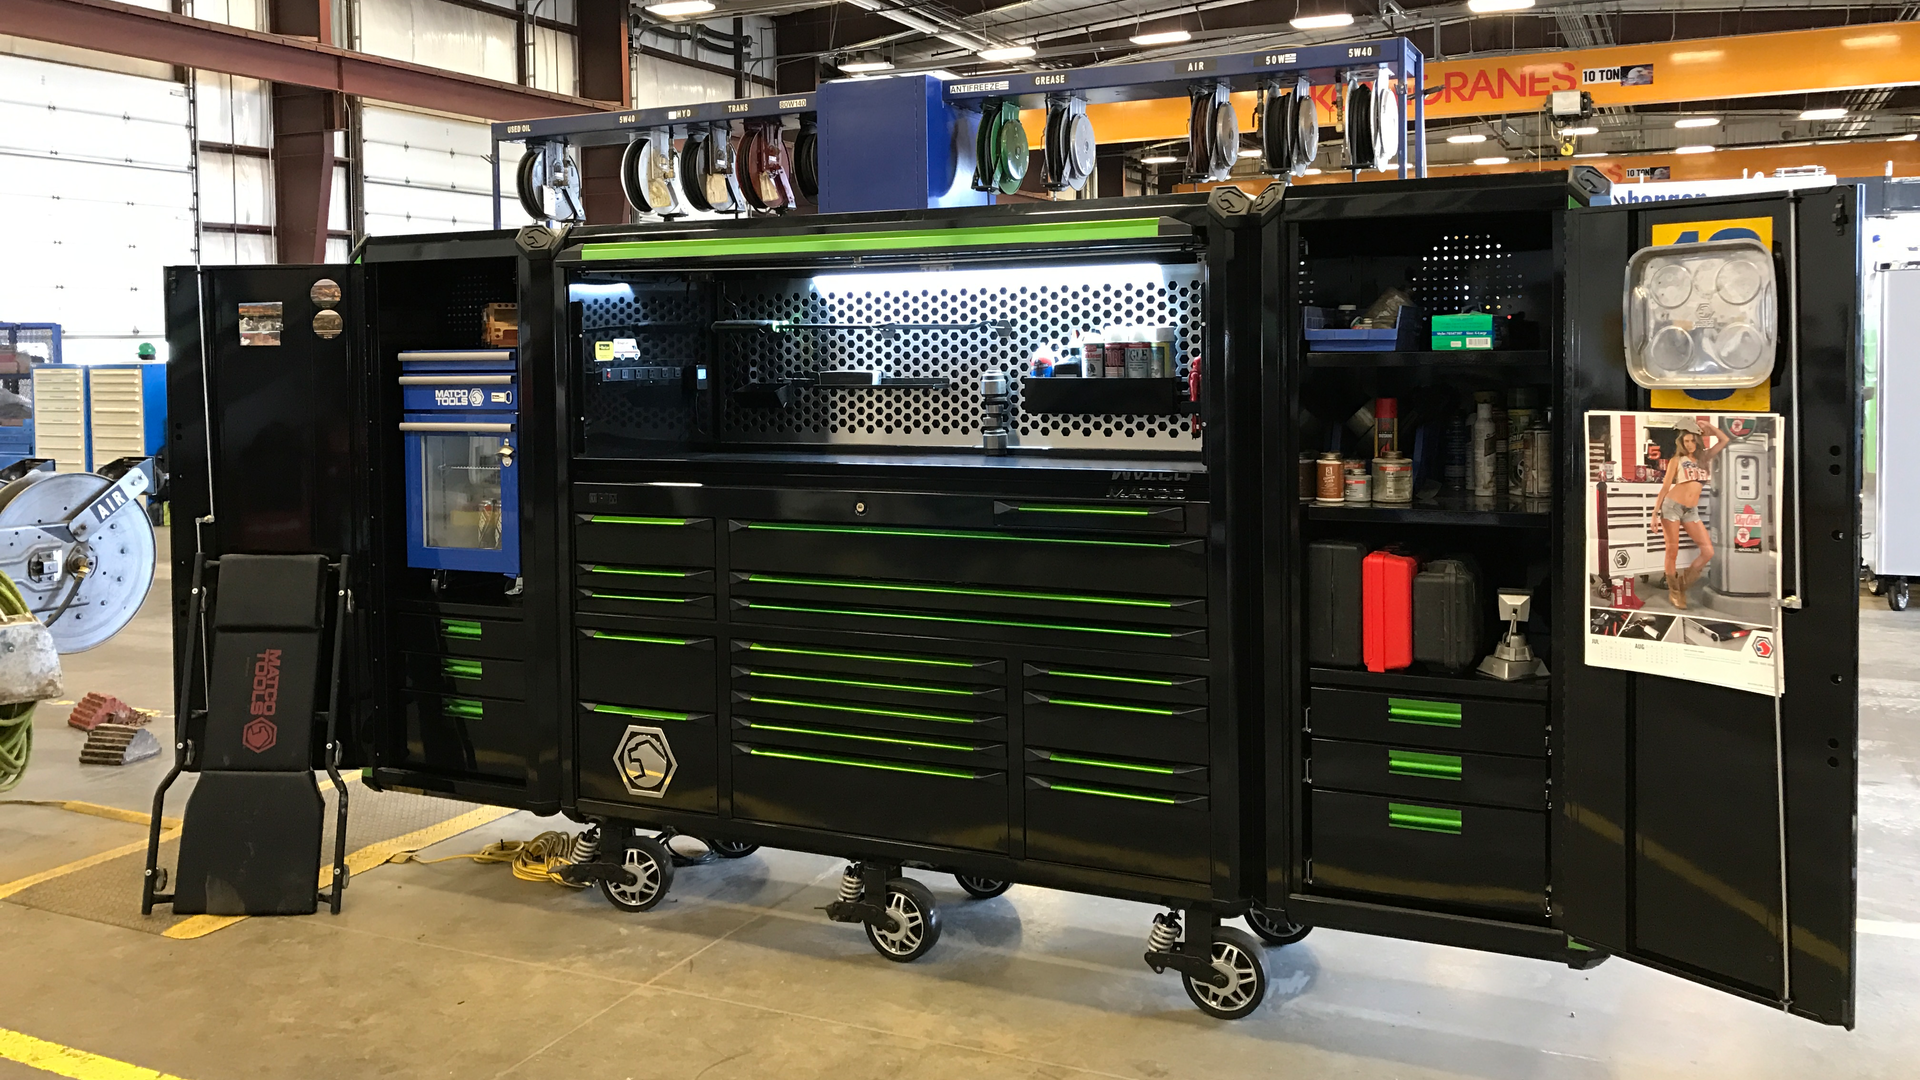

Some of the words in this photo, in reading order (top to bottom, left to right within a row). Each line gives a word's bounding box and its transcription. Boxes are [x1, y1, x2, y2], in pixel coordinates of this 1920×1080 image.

[1348, 47, 1373, 57] 5W40
[1187, 61, 1205, 72] AIR
[1035, 75, 1065, 85] GREASE
[1583, 70, 1596, 82] 10
[1599, 68, 1620, 81] TON
[950, 82, 1000, 93] ANTIFREEZE
[728, 103, 749, 113] TRANS
[619, 115, 636, 123] 5W40
[507, 125, 521, 133] USED
[522, 124, 531, 132] OIL
[1627, 169, 1635, 177] 10
[435, 389, 469, 398] MATCO
[435, 397, 469, 406] TOOLS
[1648, 445, 1661, 460] 5
[97, 490, 126, 520] AIR
[250, 653, 268, 716] TOOLS
[263, 648, 282, 716] MATCO
